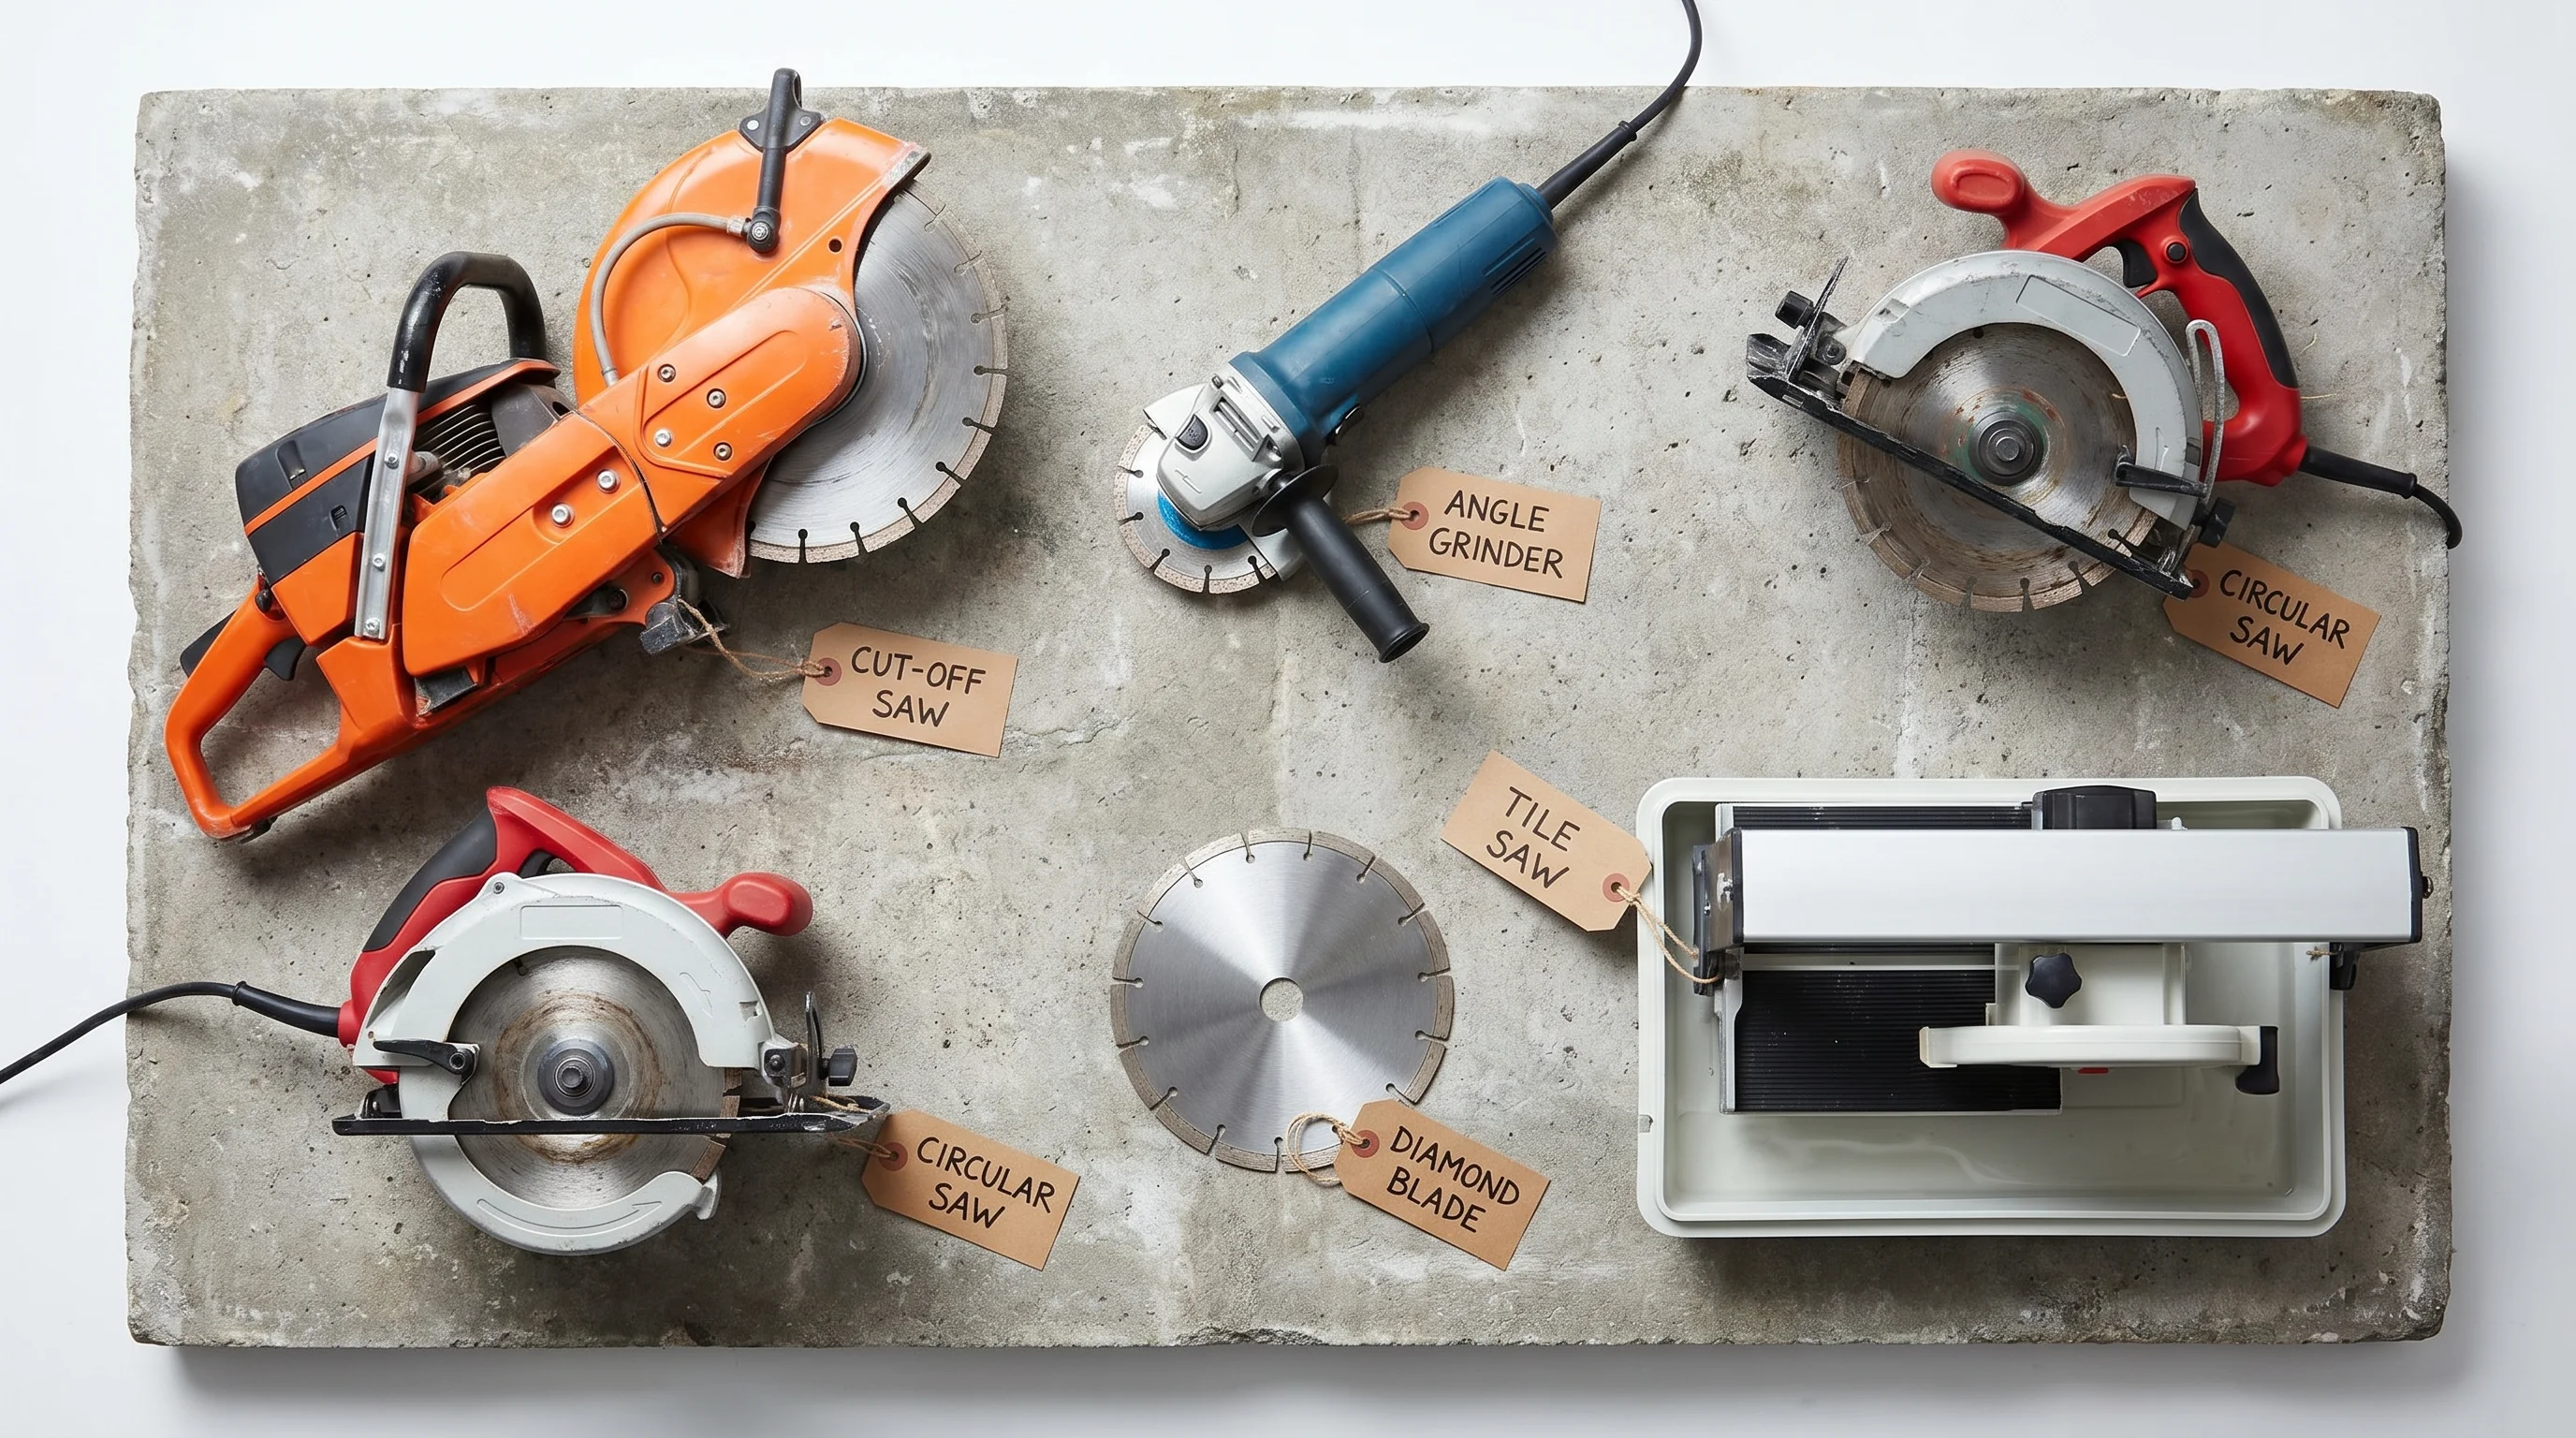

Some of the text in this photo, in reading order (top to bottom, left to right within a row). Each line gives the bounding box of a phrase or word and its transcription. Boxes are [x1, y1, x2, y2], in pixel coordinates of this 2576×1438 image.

[1444, 490, 1549, 533] ANGLE
[1430, 527, 1563, 578] GRINDER
[2219, 569, 2350, 650] CIRCULAR
[2230, 615, 2305, 666] SAW
[851, 646, 987, 695] CUT-OFF
[872, 689, 950, 727] SAW
[1506, 785, 1581, 852] TILE
[1486, 829, 1570, 888] SAW
[916, 1137, 1055, 1214] CIRCULAR
[1390, 1125, 1520, 1206] DIAMOND
[928, 1182, 1006, 1229] SAW
[1386, 1166, 1486, 1234] BLADE
